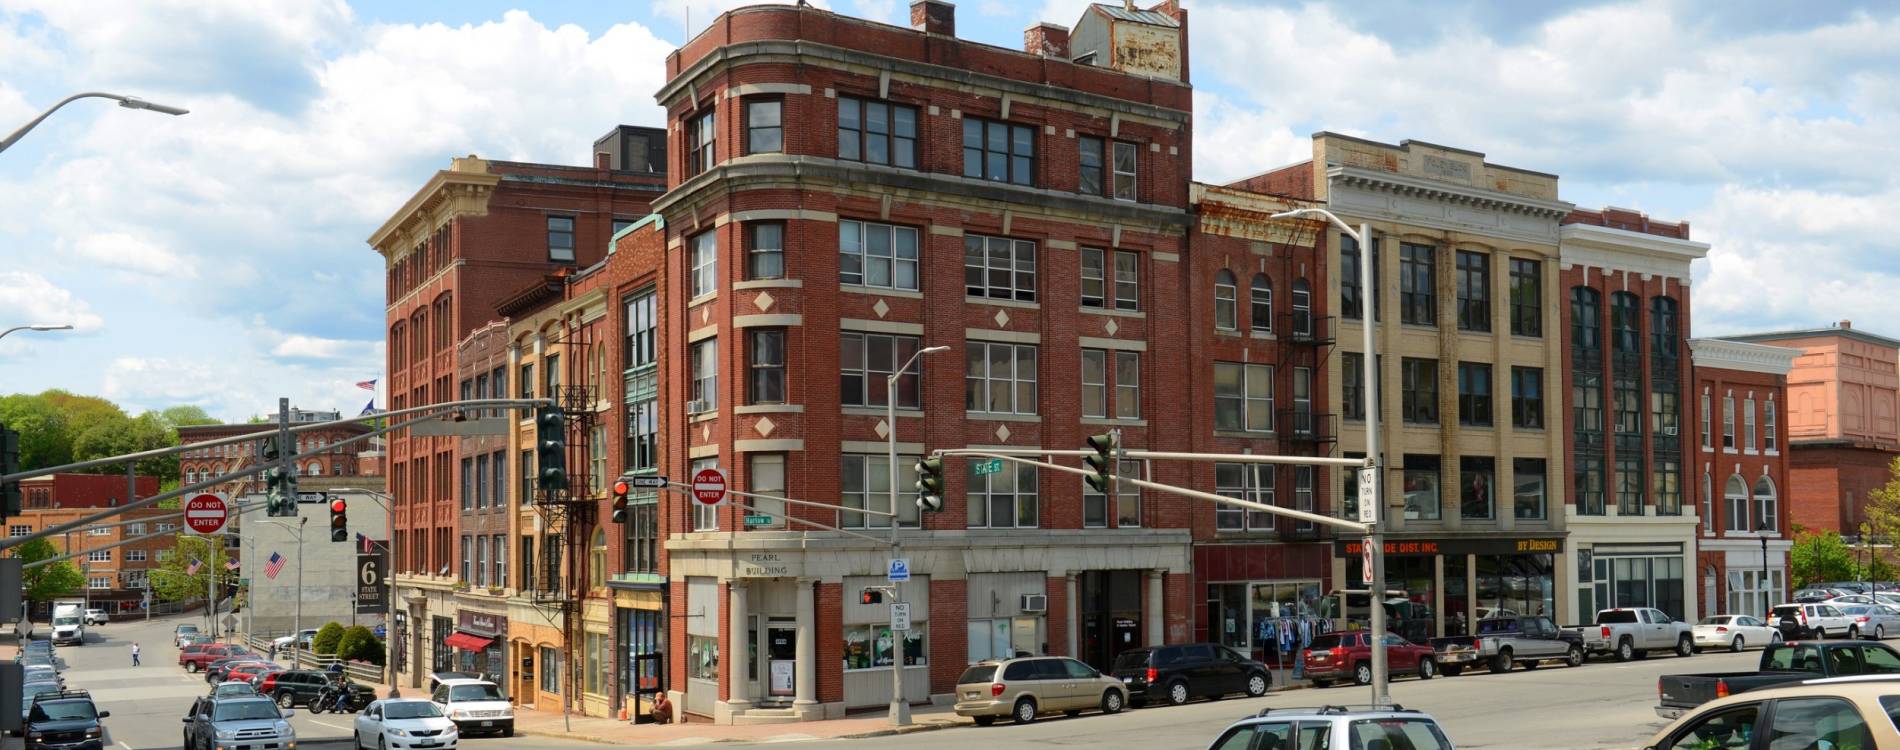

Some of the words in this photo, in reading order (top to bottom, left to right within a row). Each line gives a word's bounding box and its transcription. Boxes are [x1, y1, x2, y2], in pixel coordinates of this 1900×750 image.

[976, 463, 992, 474] STATE
[1361, 473, 1372, 484] NO
[1361, 487, 1373, 496] TURN
[1346, 543, 1396, 553] STADE
[751, 554, 780, 562] PEARL
[362, 561, 376, 585] 6
[746, 566, 787, 575] BUILDING
